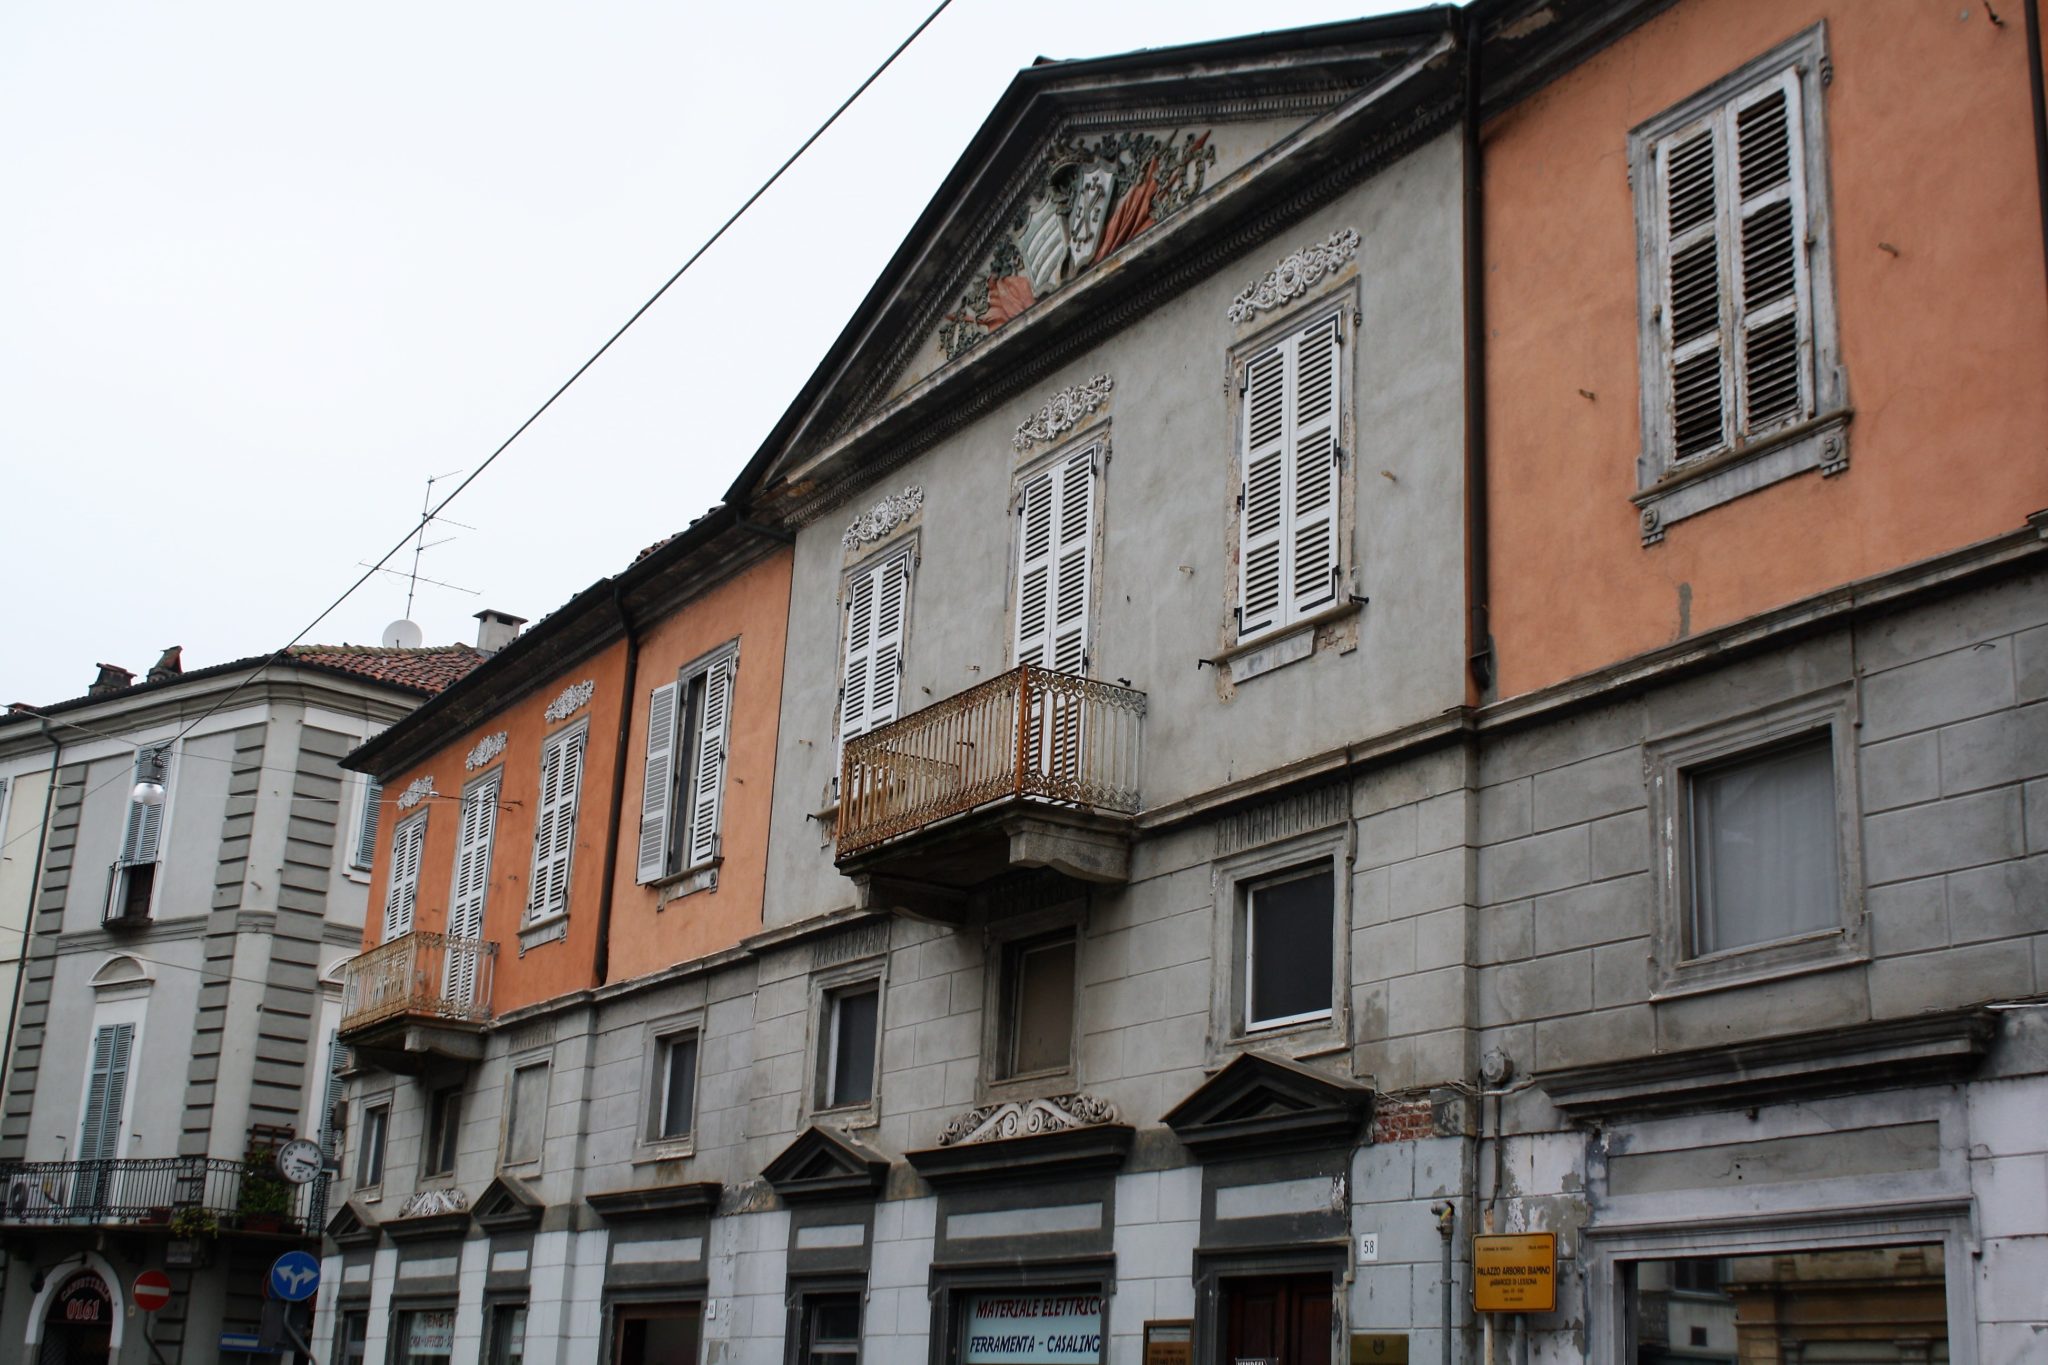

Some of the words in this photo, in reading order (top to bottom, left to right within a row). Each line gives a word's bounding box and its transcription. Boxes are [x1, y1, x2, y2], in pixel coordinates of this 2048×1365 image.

[1364, 1240, 1374, 1254] 58
[1476, 1266, 1501, 1276] PALAZZO
[1502, 1266, 1526, 1275] ARBORIO
[66, 1298, 100, 1320] 0161
[975, 1299, 1039, 1319] MATERIALE
[969, 1335, 1035, 1353] FERRAMENTA
